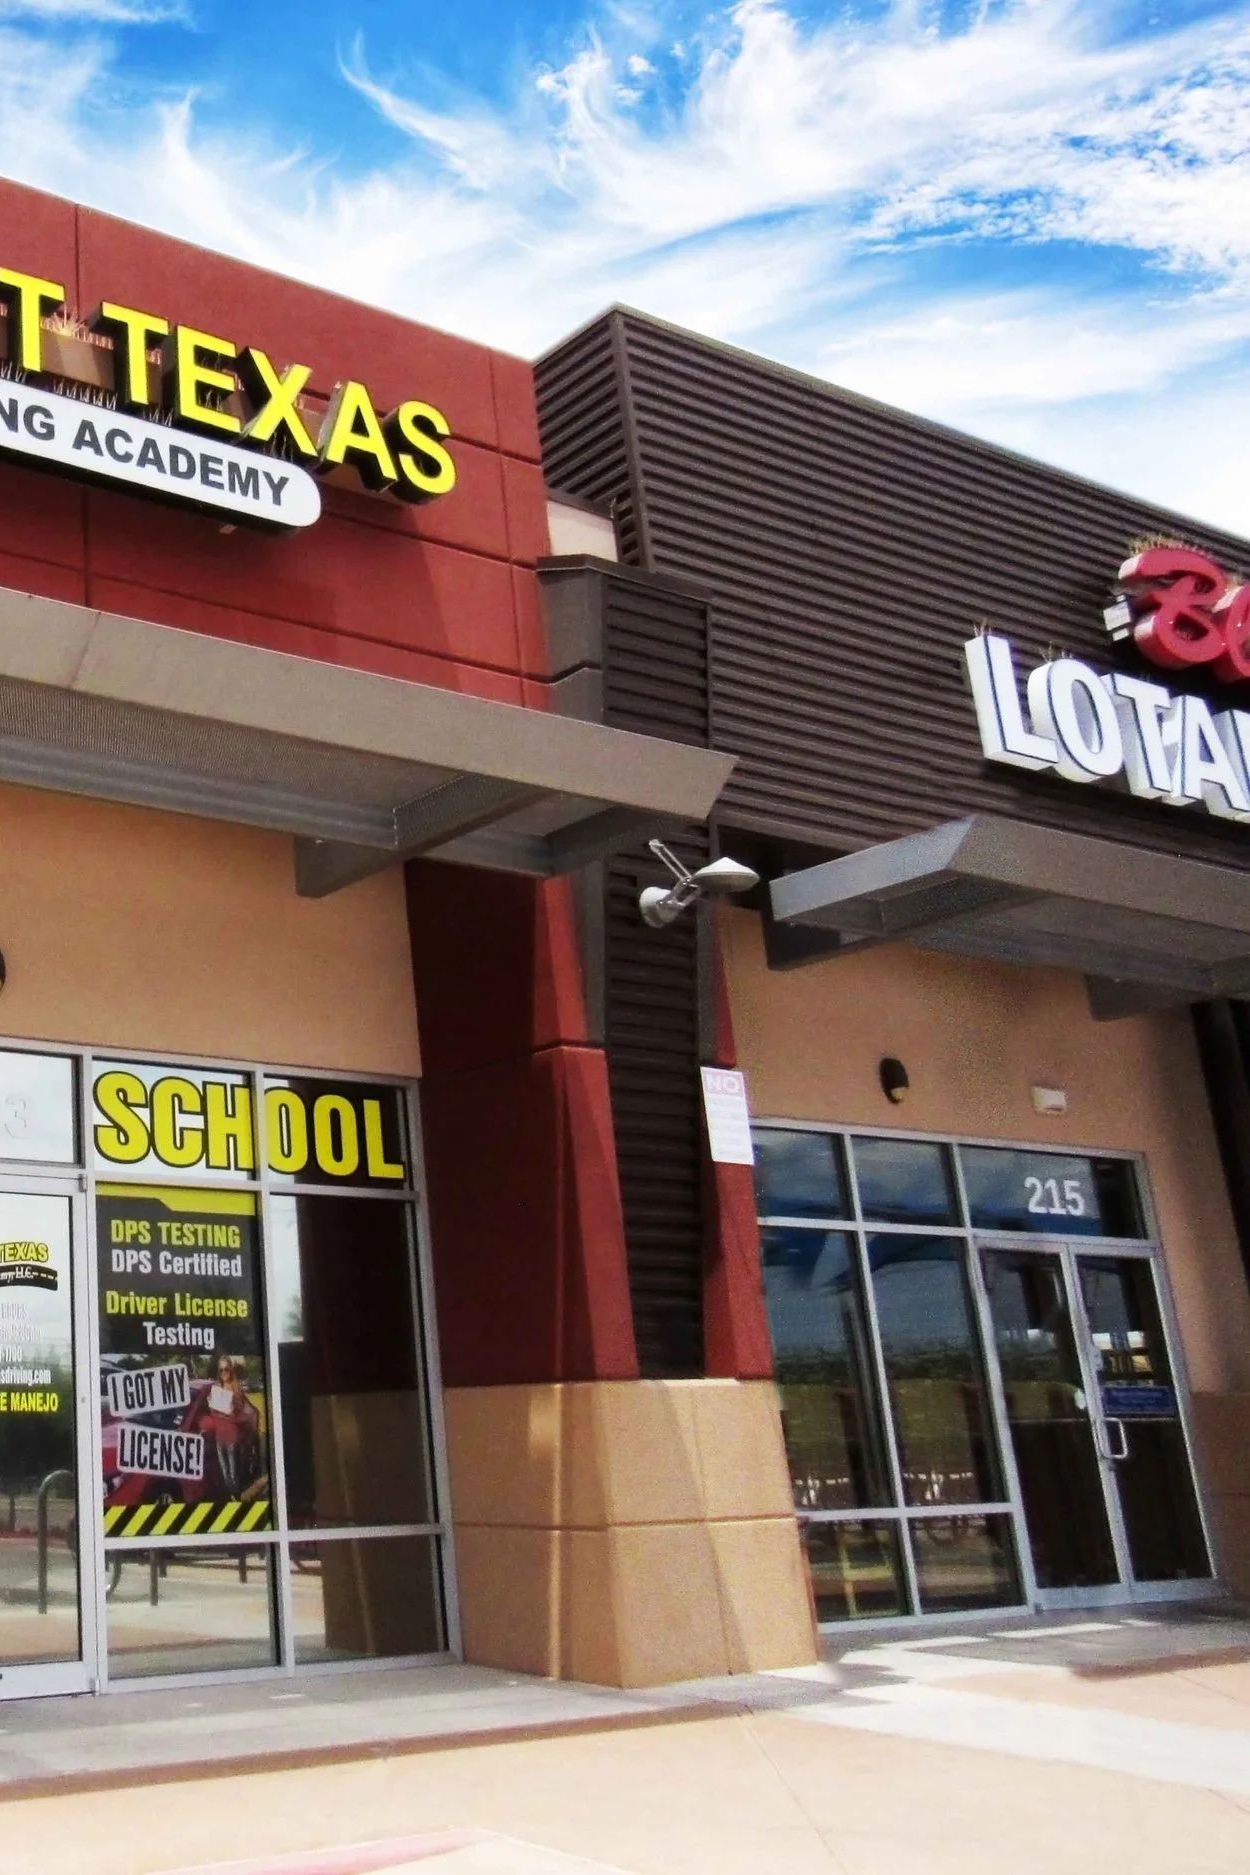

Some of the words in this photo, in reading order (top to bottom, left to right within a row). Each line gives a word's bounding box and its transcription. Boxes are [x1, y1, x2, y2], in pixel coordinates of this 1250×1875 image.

[101, 301, 457, 496] TEXAS
[72, 419, 290, 507] ACADEMY
[965, 634, 1250, 818] LOTA
[93, 1070, 406, 1180] SCHOOL
[1024, 1177, 1085, 1216] 215
[111, 1220, 150, 1244] DPS
[157, 1222, 241, 1248] TESTING
[111, 1250, 151, 1274] DPS
[159, 1251, 242, 1277] Certified
[106, 1291, 167, 1315] Driver
[174, 1292, 248, 1318] License
[143, 1322, 215, 1350] Testing
[11, 1392, 59, 1412] MANEJO
[111, 1377, 119, 1411] I
[123, 1373, 155, 1408] GOT
[161, 1367, 186, 1405] MY
[120, 1428, 200, 1475] LICENSE!
